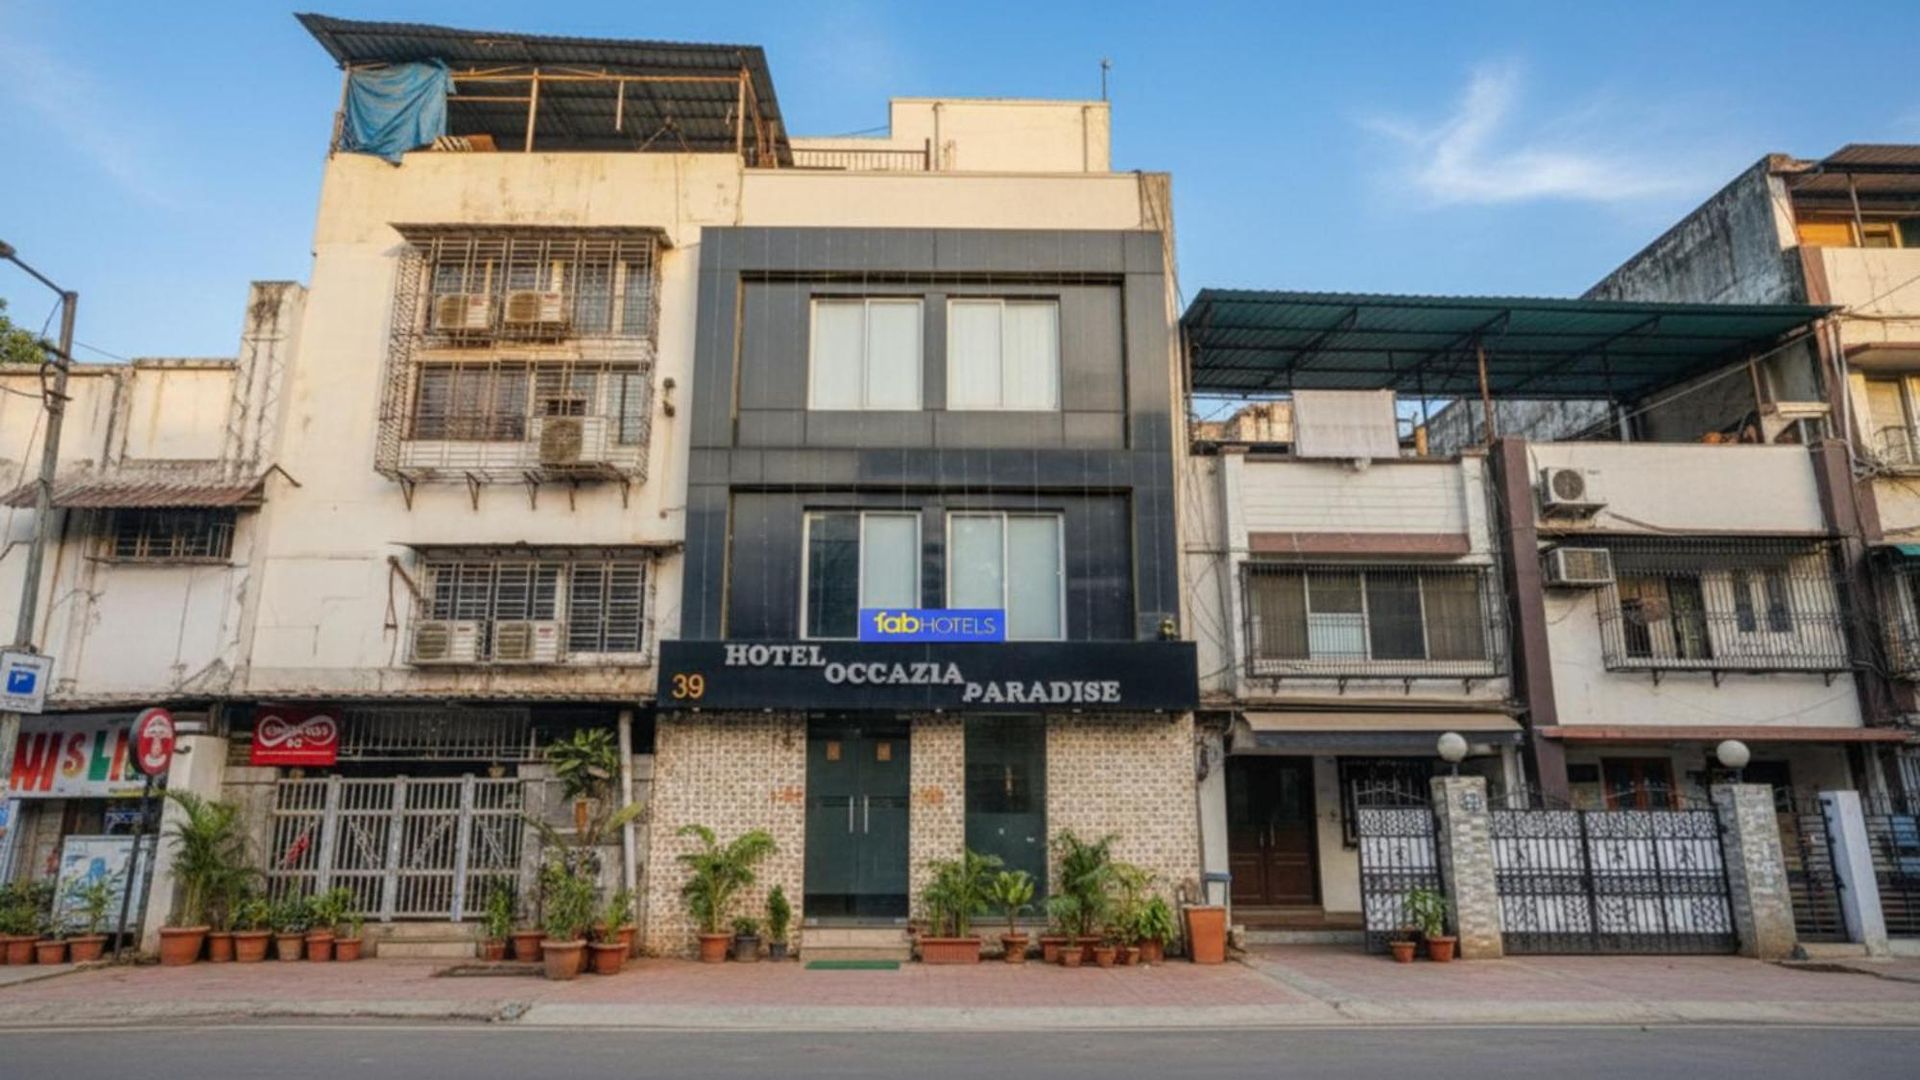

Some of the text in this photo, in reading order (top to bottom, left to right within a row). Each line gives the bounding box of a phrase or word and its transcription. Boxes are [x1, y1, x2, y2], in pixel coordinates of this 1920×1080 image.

[873, 611, 996, 635] fabHOTELS
[671, 673, 704, 699] 39
[724, 644, 1121, 703] HOTEL OCCAZIA PARADISE
